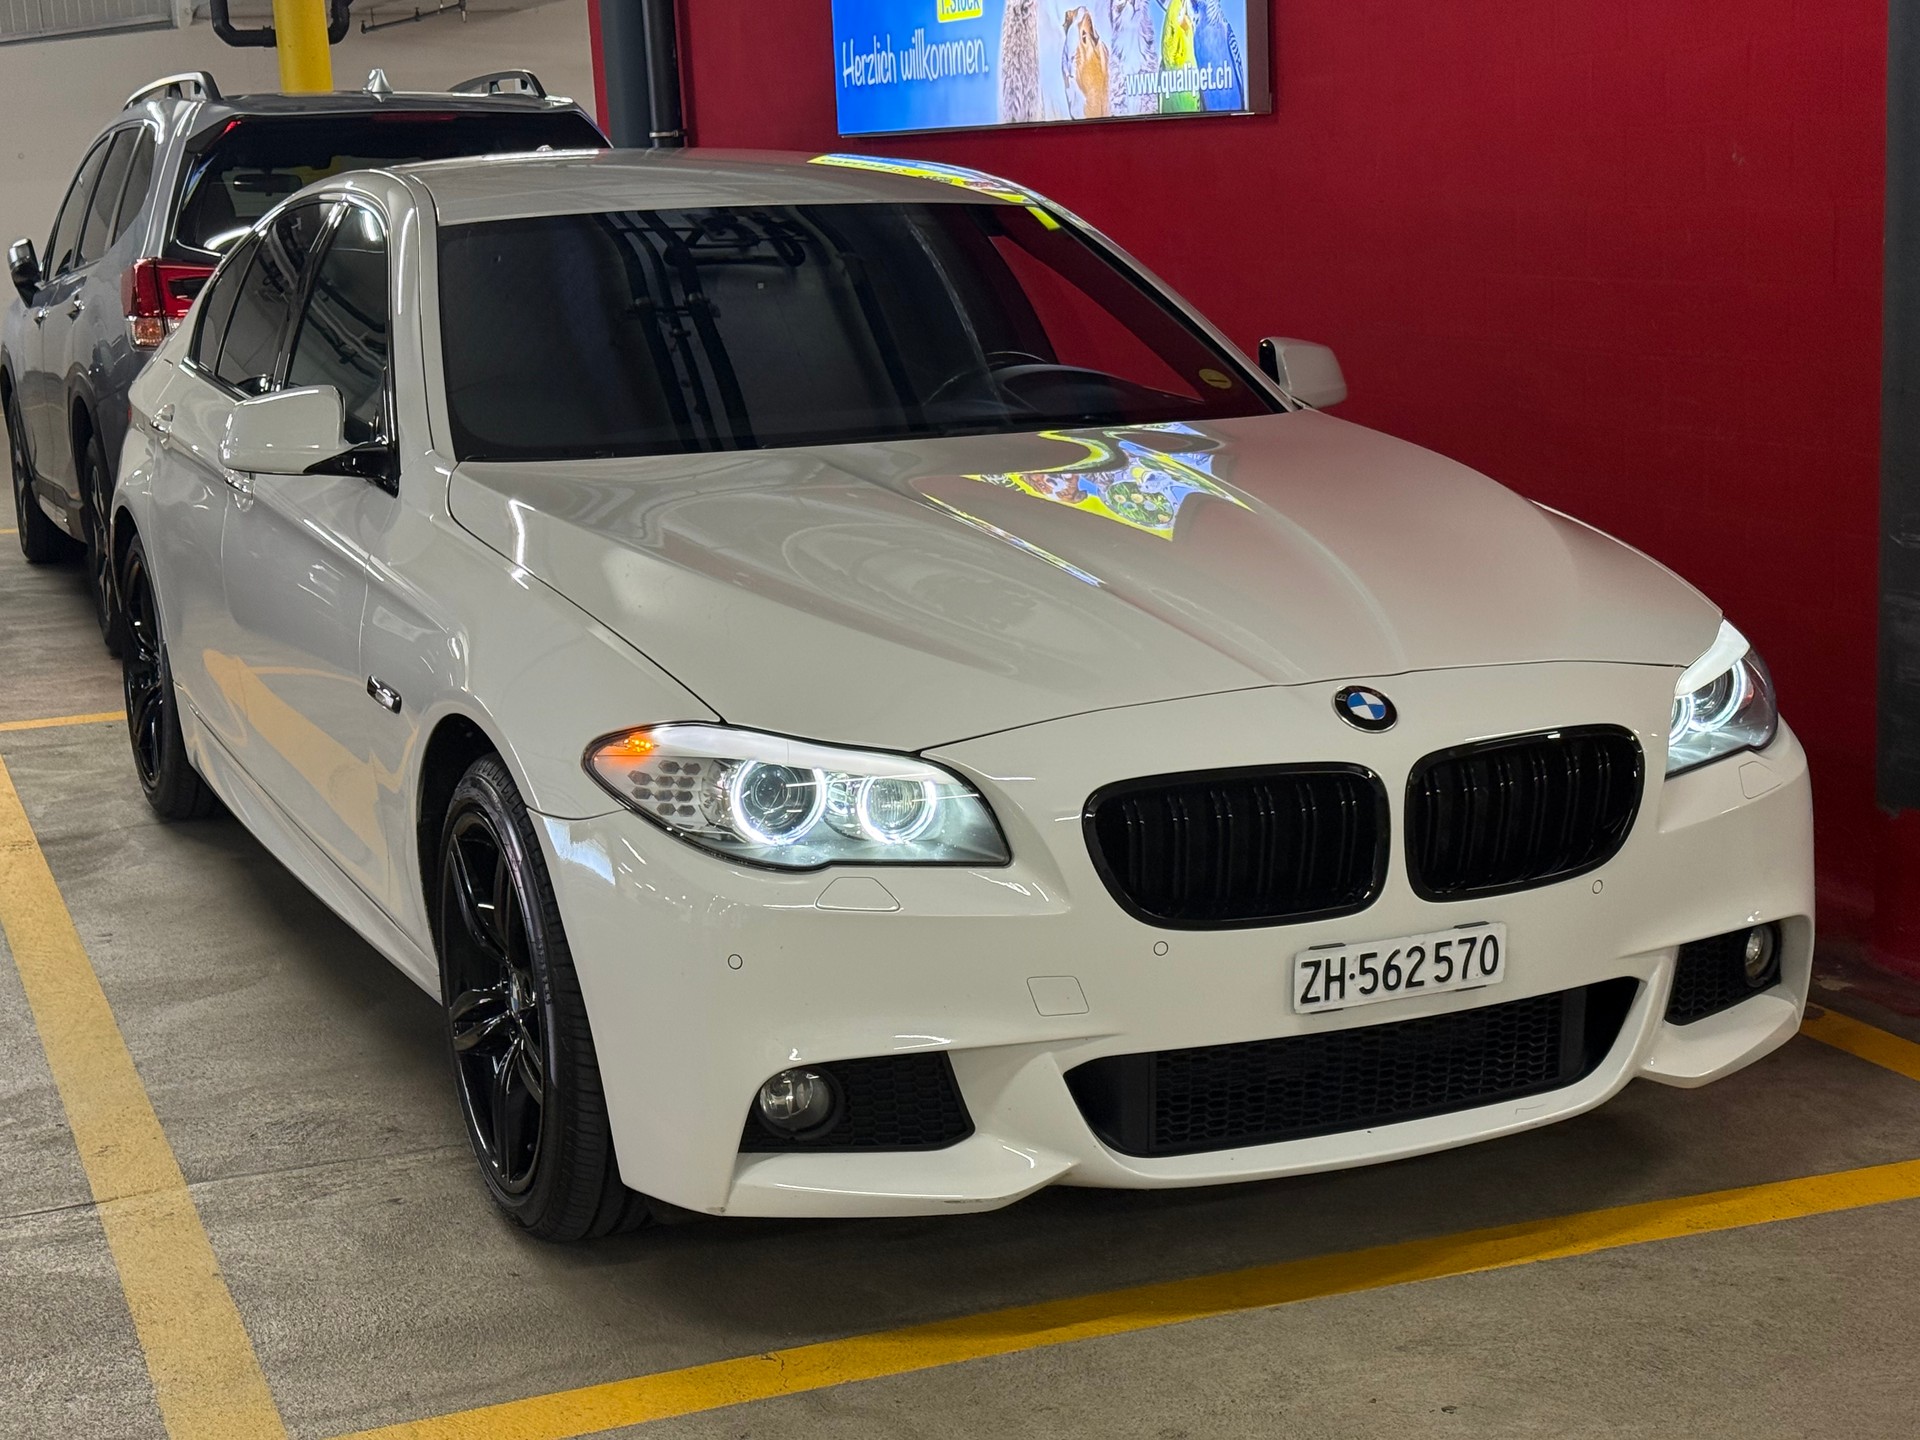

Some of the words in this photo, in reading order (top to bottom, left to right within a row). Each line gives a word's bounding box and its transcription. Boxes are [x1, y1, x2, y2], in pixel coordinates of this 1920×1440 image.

[842, 33, 898, 89] Herzlich
[900, 27, 990, 82] willkommen.
[1126, 60, 1233, 99] www.qualipet.ch
